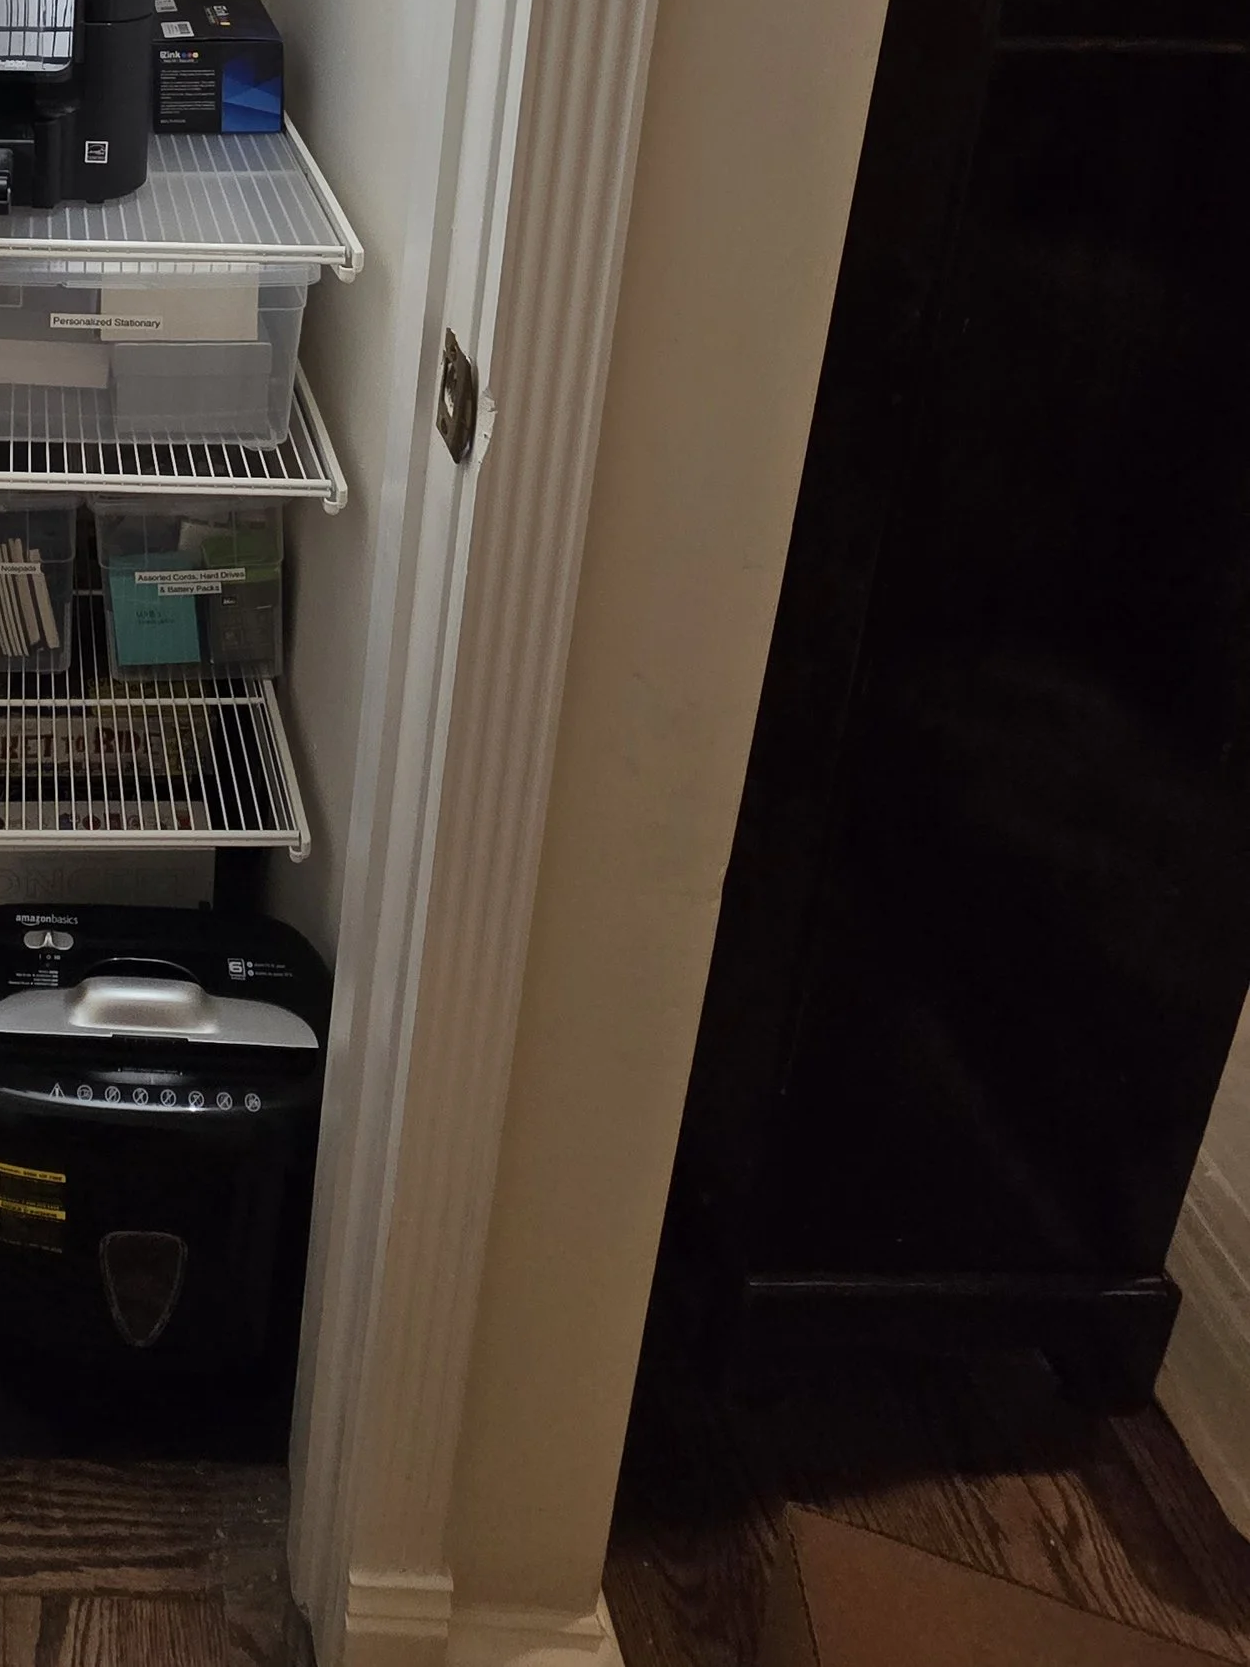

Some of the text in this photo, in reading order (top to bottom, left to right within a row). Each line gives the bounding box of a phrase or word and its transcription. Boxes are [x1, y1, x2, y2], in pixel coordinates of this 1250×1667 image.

[53, 316, 161, 328] Personalized Stationary
[200, 572, 219, 580] Hard
[220, 571, 245, 579] Drives
[167, 585, 194, 594] Battery
[196, 584, 220, 592] Packs
[229, 961, 243, 974] 6
